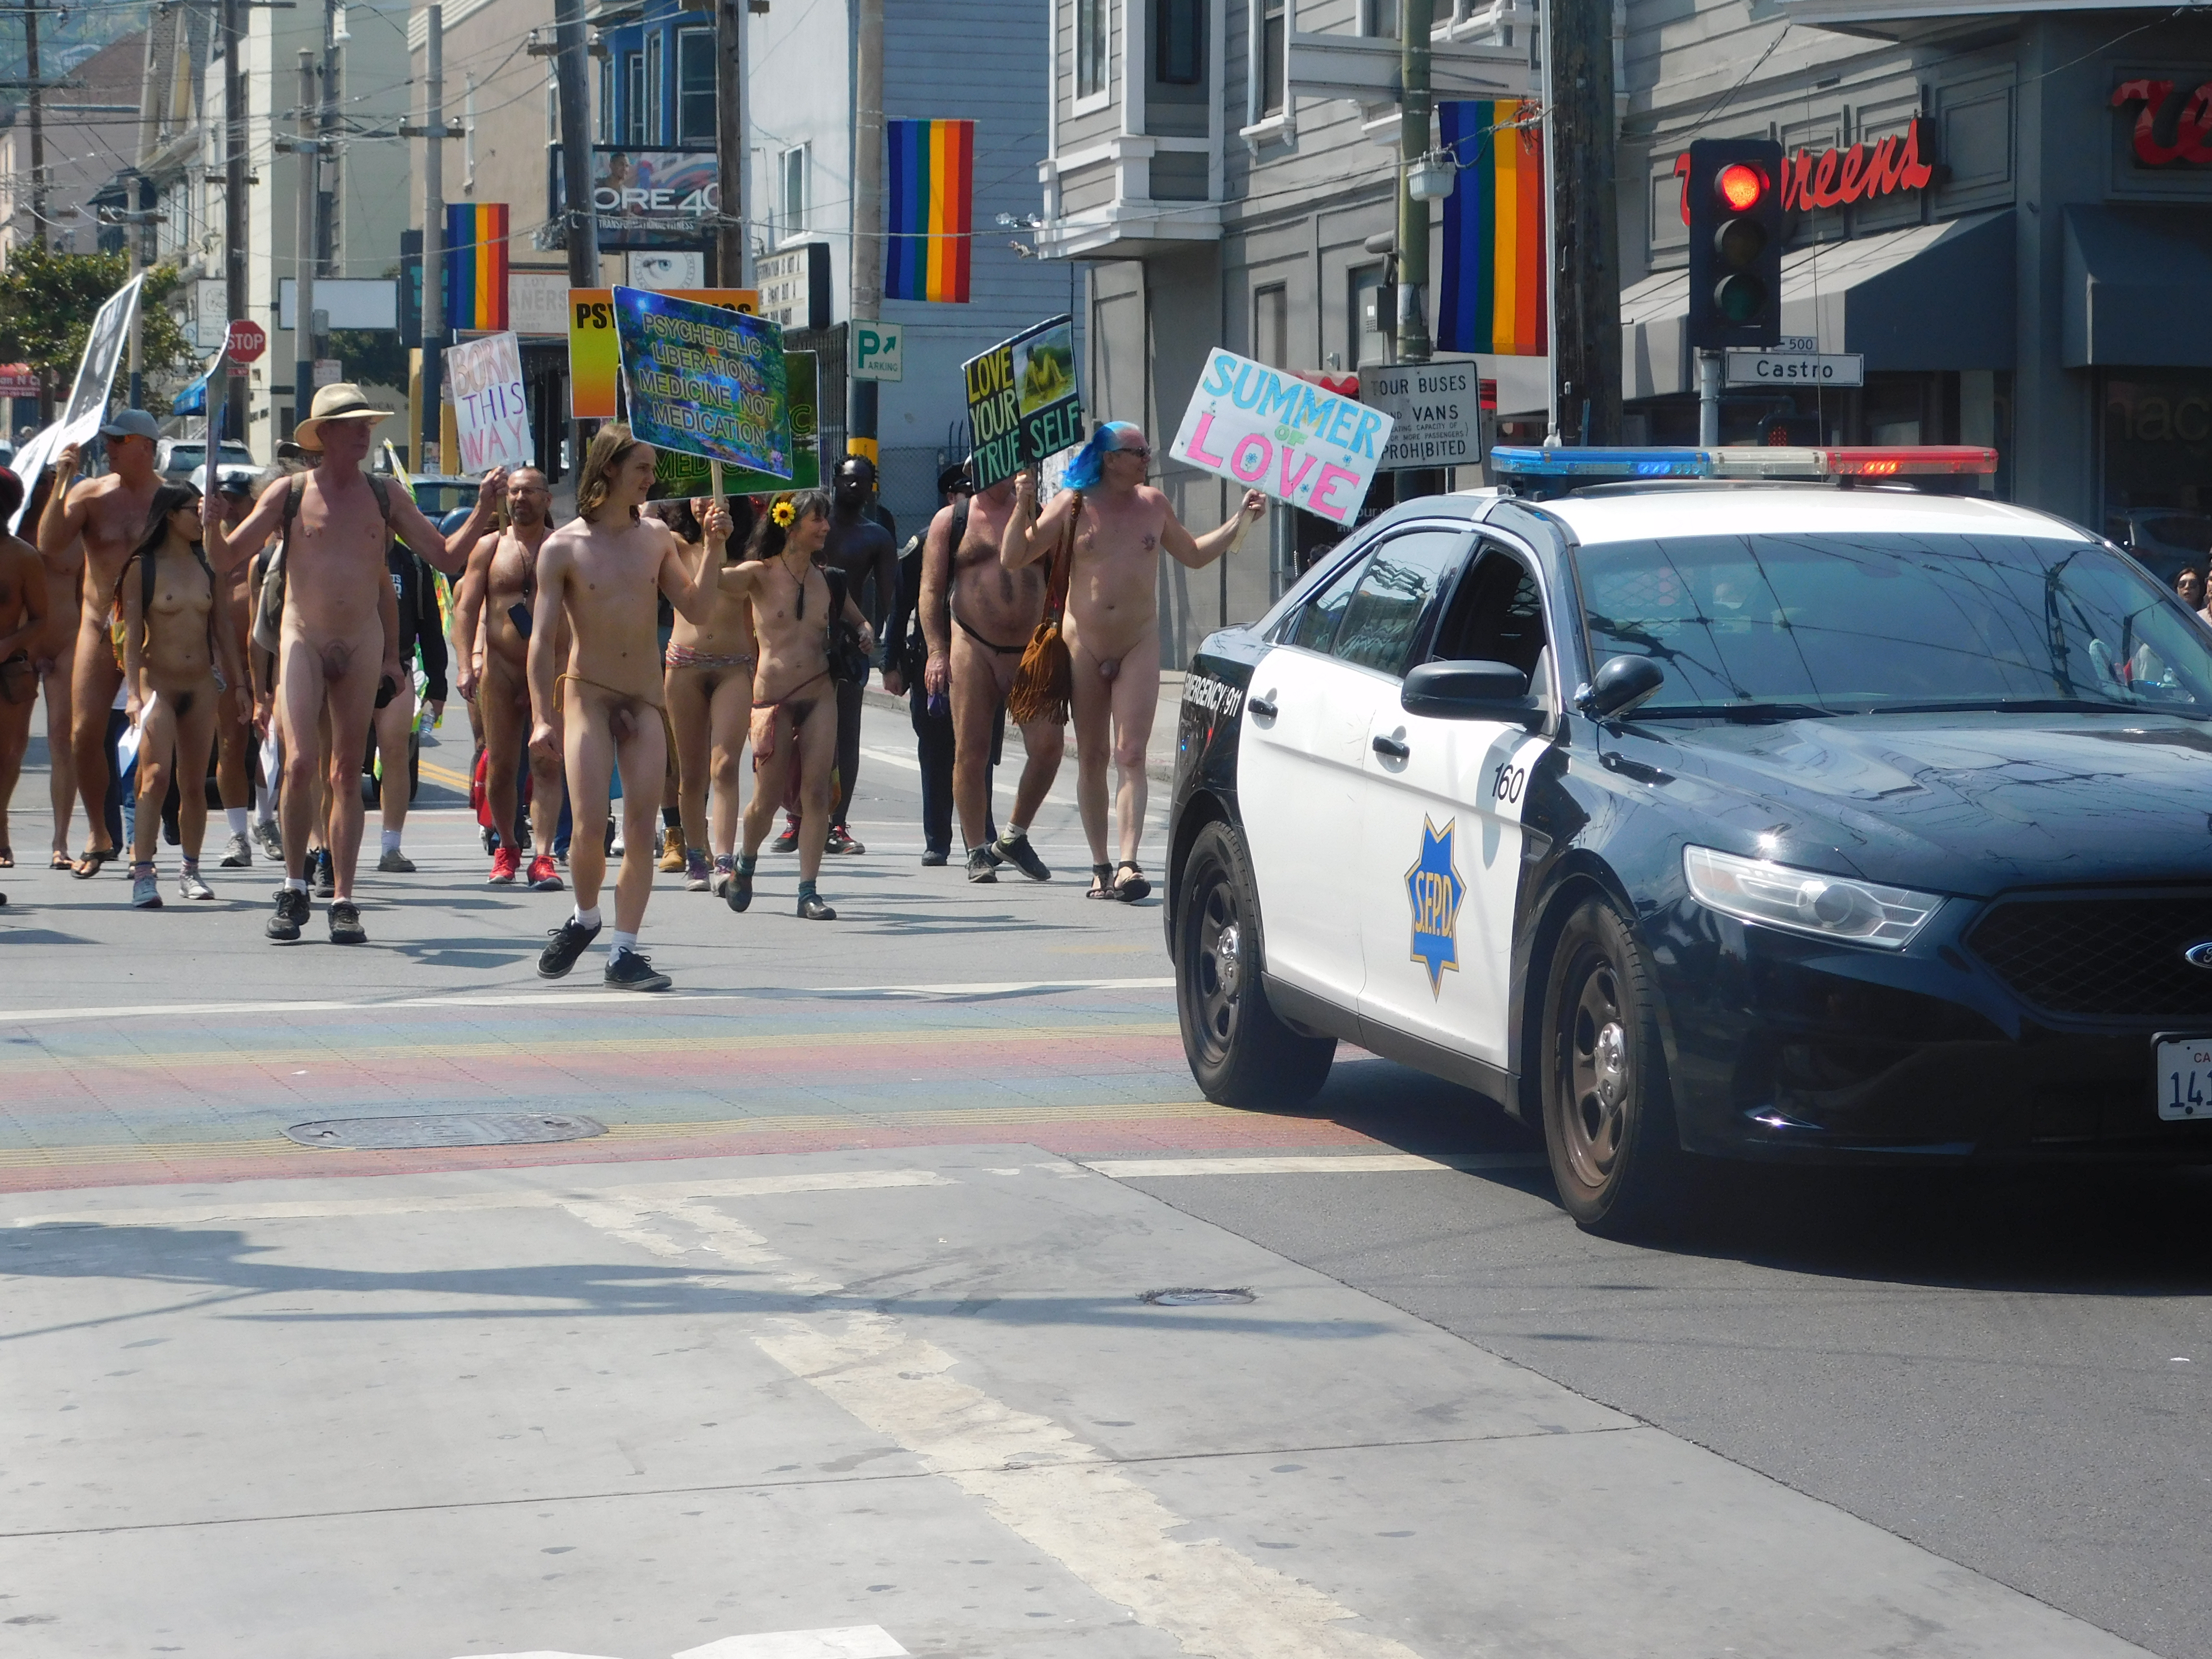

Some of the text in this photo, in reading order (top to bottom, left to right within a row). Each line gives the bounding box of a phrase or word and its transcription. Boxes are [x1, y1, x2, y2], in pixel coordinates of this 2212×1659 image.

[228, 333, 264, 350] STOP
[643, 313, 762, 358] PSYCHEDELIC
[1790, 338, 1813, 350] 500
[451, 335, 519, 397] BORN
[652, 342, 757, 385] LIBERATION:
[966, 346, 1013, 404] LOVE
[1370, 375, 1466, 396] TOUR BUSES
[1756, 360, 1833, 378] Castro
[462, 382, 524, 429] THIS
[638, 369, 780, 421] MEDICINE NOT
[1202, 355, 1382, 459] SUMMER
[1412, 405, 1459, 421] VANS
[652, 401, 767, 448] MEDICATION
[969, 389, 1019, 446] YOUR
[1274, 425, 1308, 446] OF
[1416, 422, 1445, 431] CAPACITY
[460, 416, 523, 468] WAY
[974, 400, 1080, 489] TRUE SELF
[1381, 440, 1466, 460] PROHIBITED
[1185, 412, 1360, 521] LOVE
[1183, 673, 1243, 717] EMERGENCY 911
[1492, 762, 1524, 804] 160
